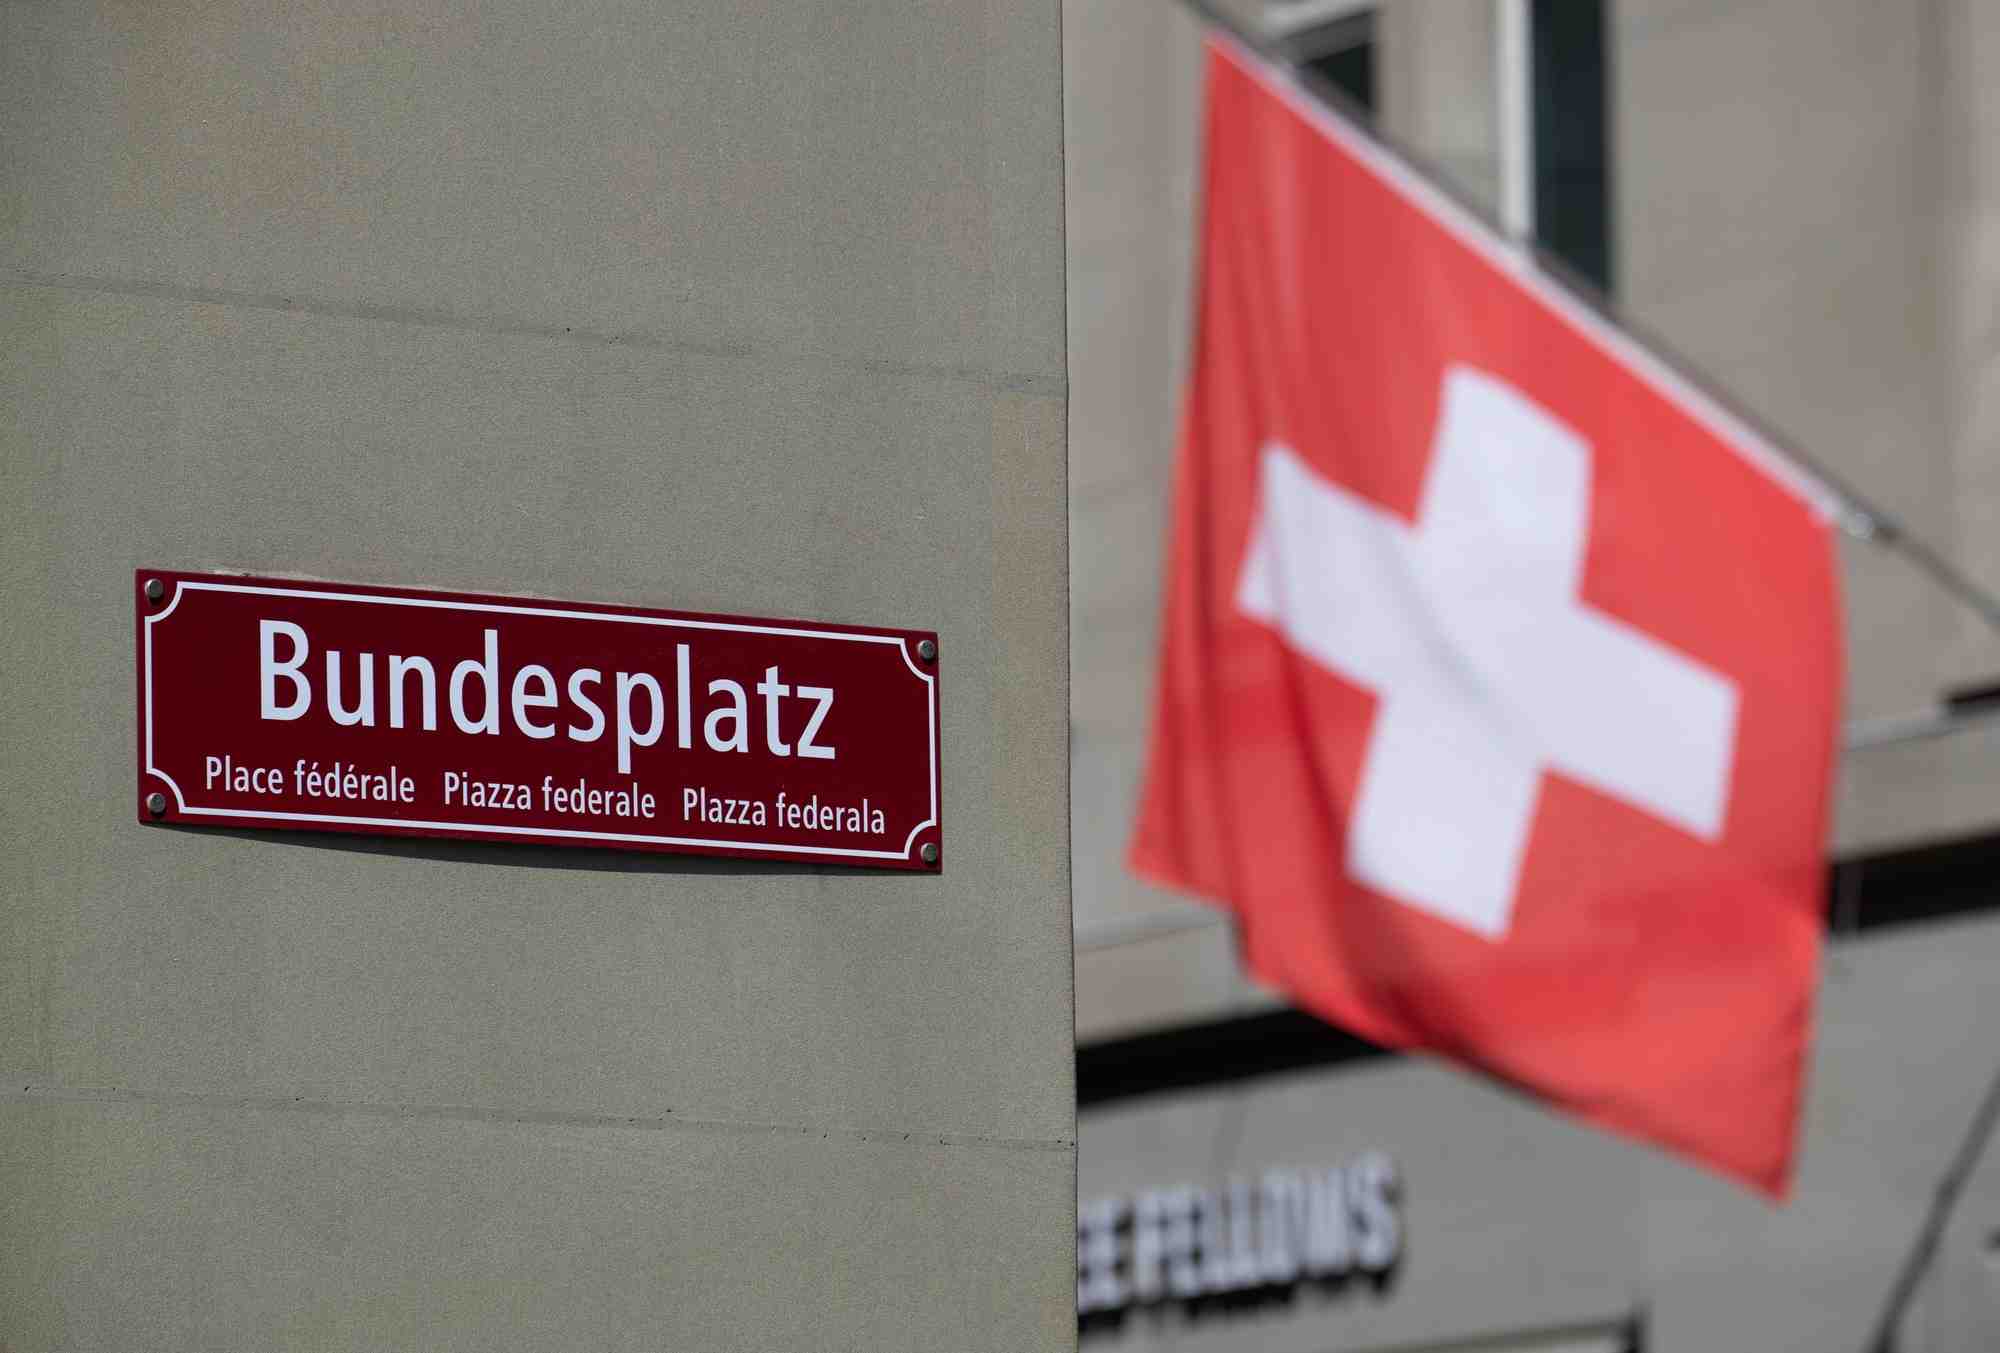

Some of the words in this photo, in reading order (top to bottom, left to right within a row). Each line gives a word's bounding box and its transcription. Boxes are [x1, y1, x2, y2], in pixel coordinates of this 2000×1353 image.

[258, 618, 837, 775] Bundesplatz
[205, 755, 284, 794] Place
[293, 759, 415, 803] fédérale
[443, 770, 532, 810] Piazza
[541, 775, 656, 818] federale
[683, 786, 766, 826] Plazza
[775, 792, 886, 834] federala
